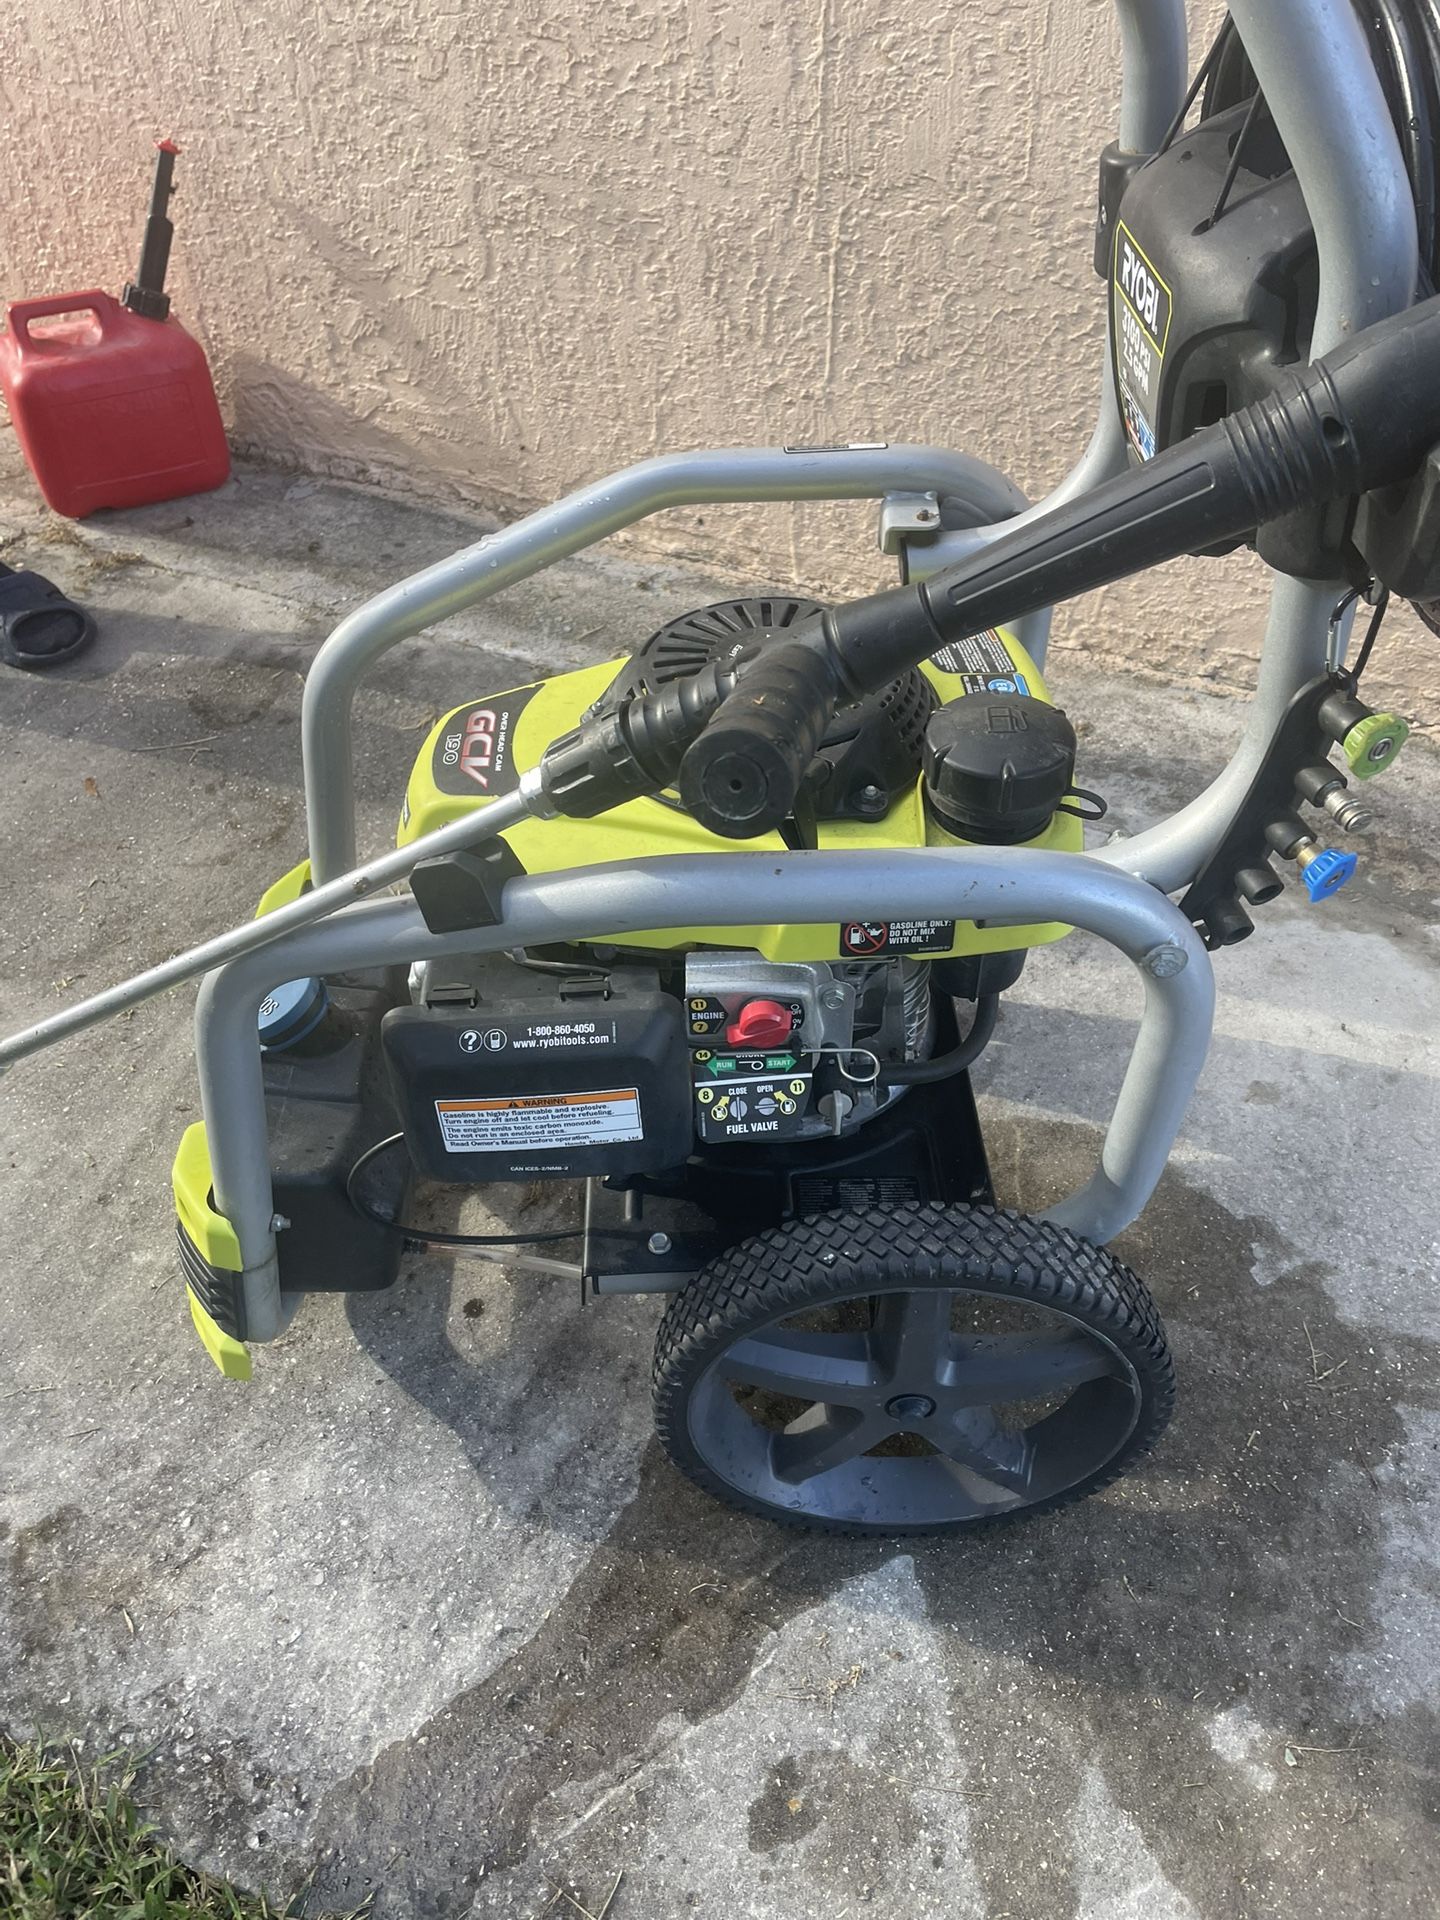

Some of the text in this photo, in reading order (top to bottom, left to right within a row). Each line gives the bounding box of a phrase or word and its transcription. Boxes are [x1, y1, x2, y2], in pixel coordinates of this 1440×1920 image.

[1122, 241, 1159, 332] RYOBI
[1122, 305, 1140, 353] 3100
[1140, 341, 1151, 372] PSI
[1133, 354, 1149, 396] GPM
[495, 712, 508, 771] OVER HEAD CAM
[460, 709, 496, 790] GCV
[890, 920, 928, 930] GASOLINE
[902, 928, 918, 936] NOT
[919, 927, 936, 935] MIX
[889, 936, 910, 945] WITH
[911, 935, 924, 943] OIL
[691, 1011, 725, 1021] ENGINE
[527, 1023, 595, 1037] 1-800-860-4050
[513, 1034, 609, 1049] www.ryobitools.com
[716, 1061, 733, 1069] RUN
[767, 1058, 791, 1067] START
[728, 1087, 748, 1096] CLOSE
[756, 1084, 774, 1093] OPEN
[522, 1097, 568, 1107] WARNING
[486, 1109, 510, 1117] highly
[511, 1107, 553, 1116] flammable
[726, 1120, 778, 1135] FUEL VALVE
